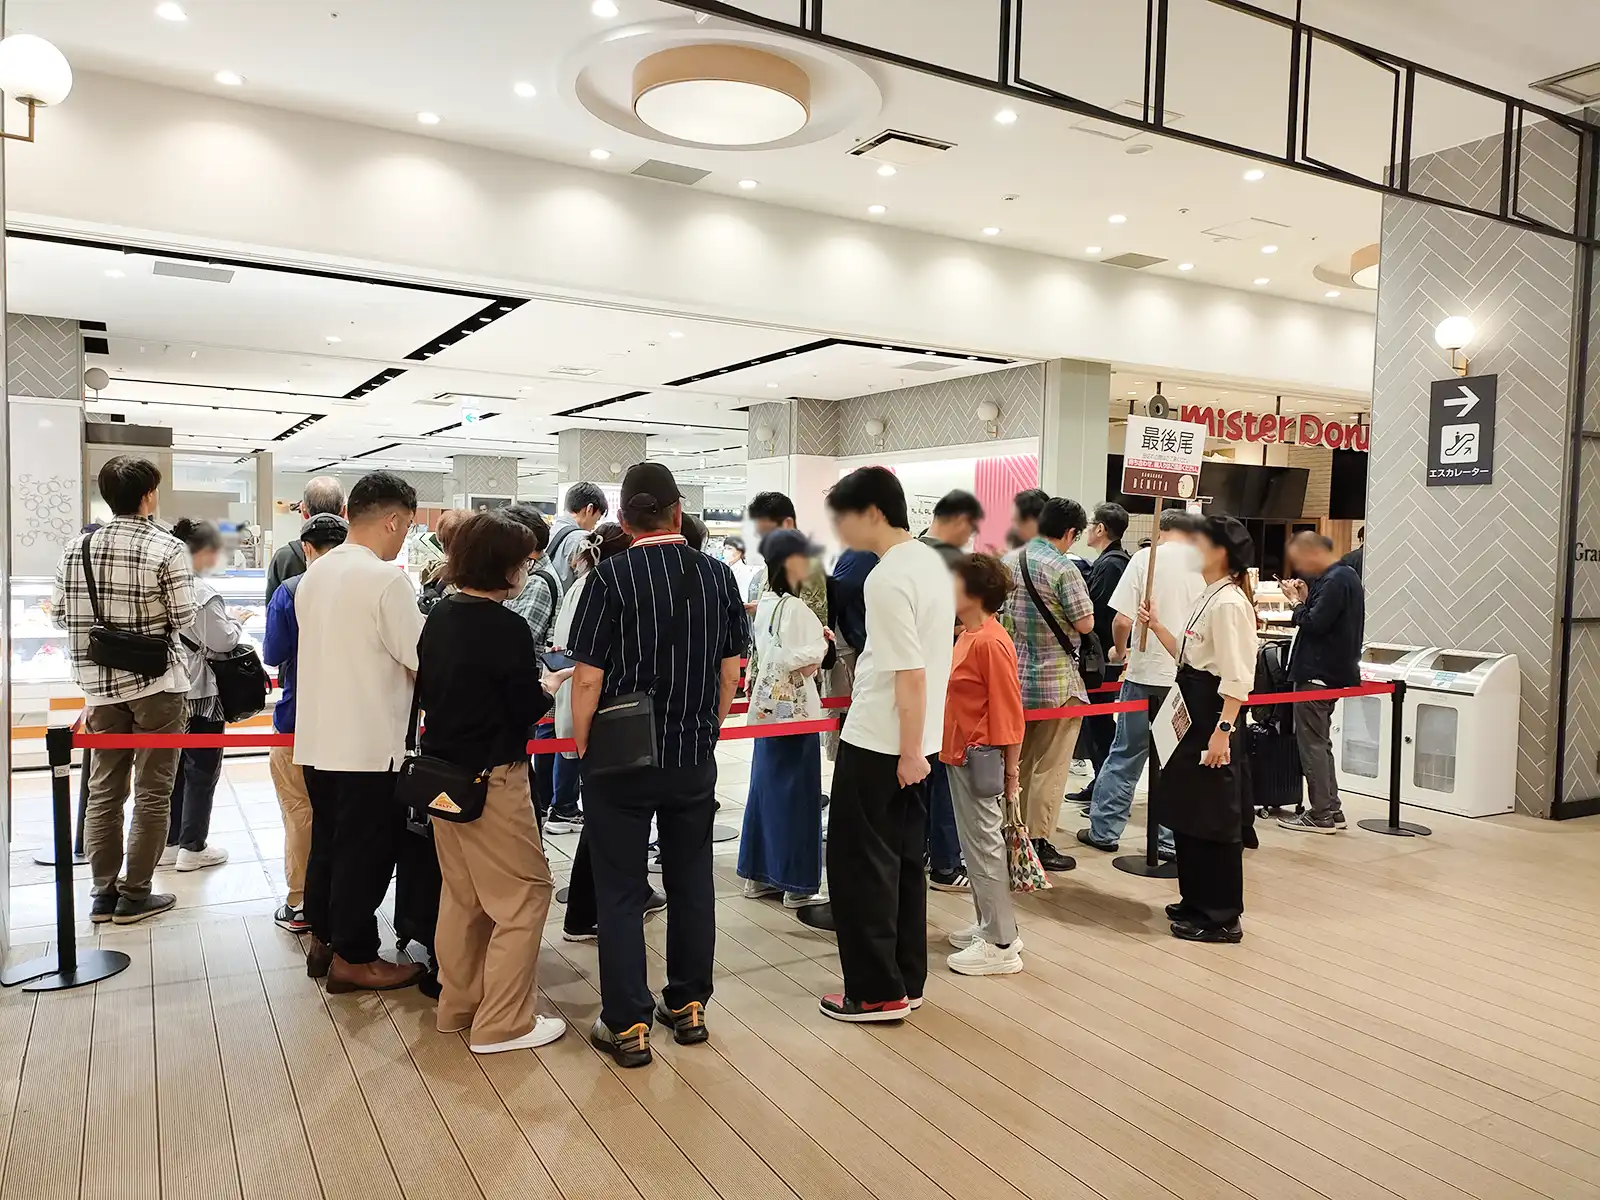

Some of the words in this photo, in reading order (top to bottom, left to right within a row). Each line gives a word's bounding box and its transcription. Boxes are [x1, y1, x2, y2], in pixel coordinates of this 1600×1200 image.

[1181, 405, 1296, 443] Mister
[1141, 426, 1194, 455] 最後尾
[1429, 467, 1489, 478] エスカレーター
[1575, 542, 1600, 562] Gra
